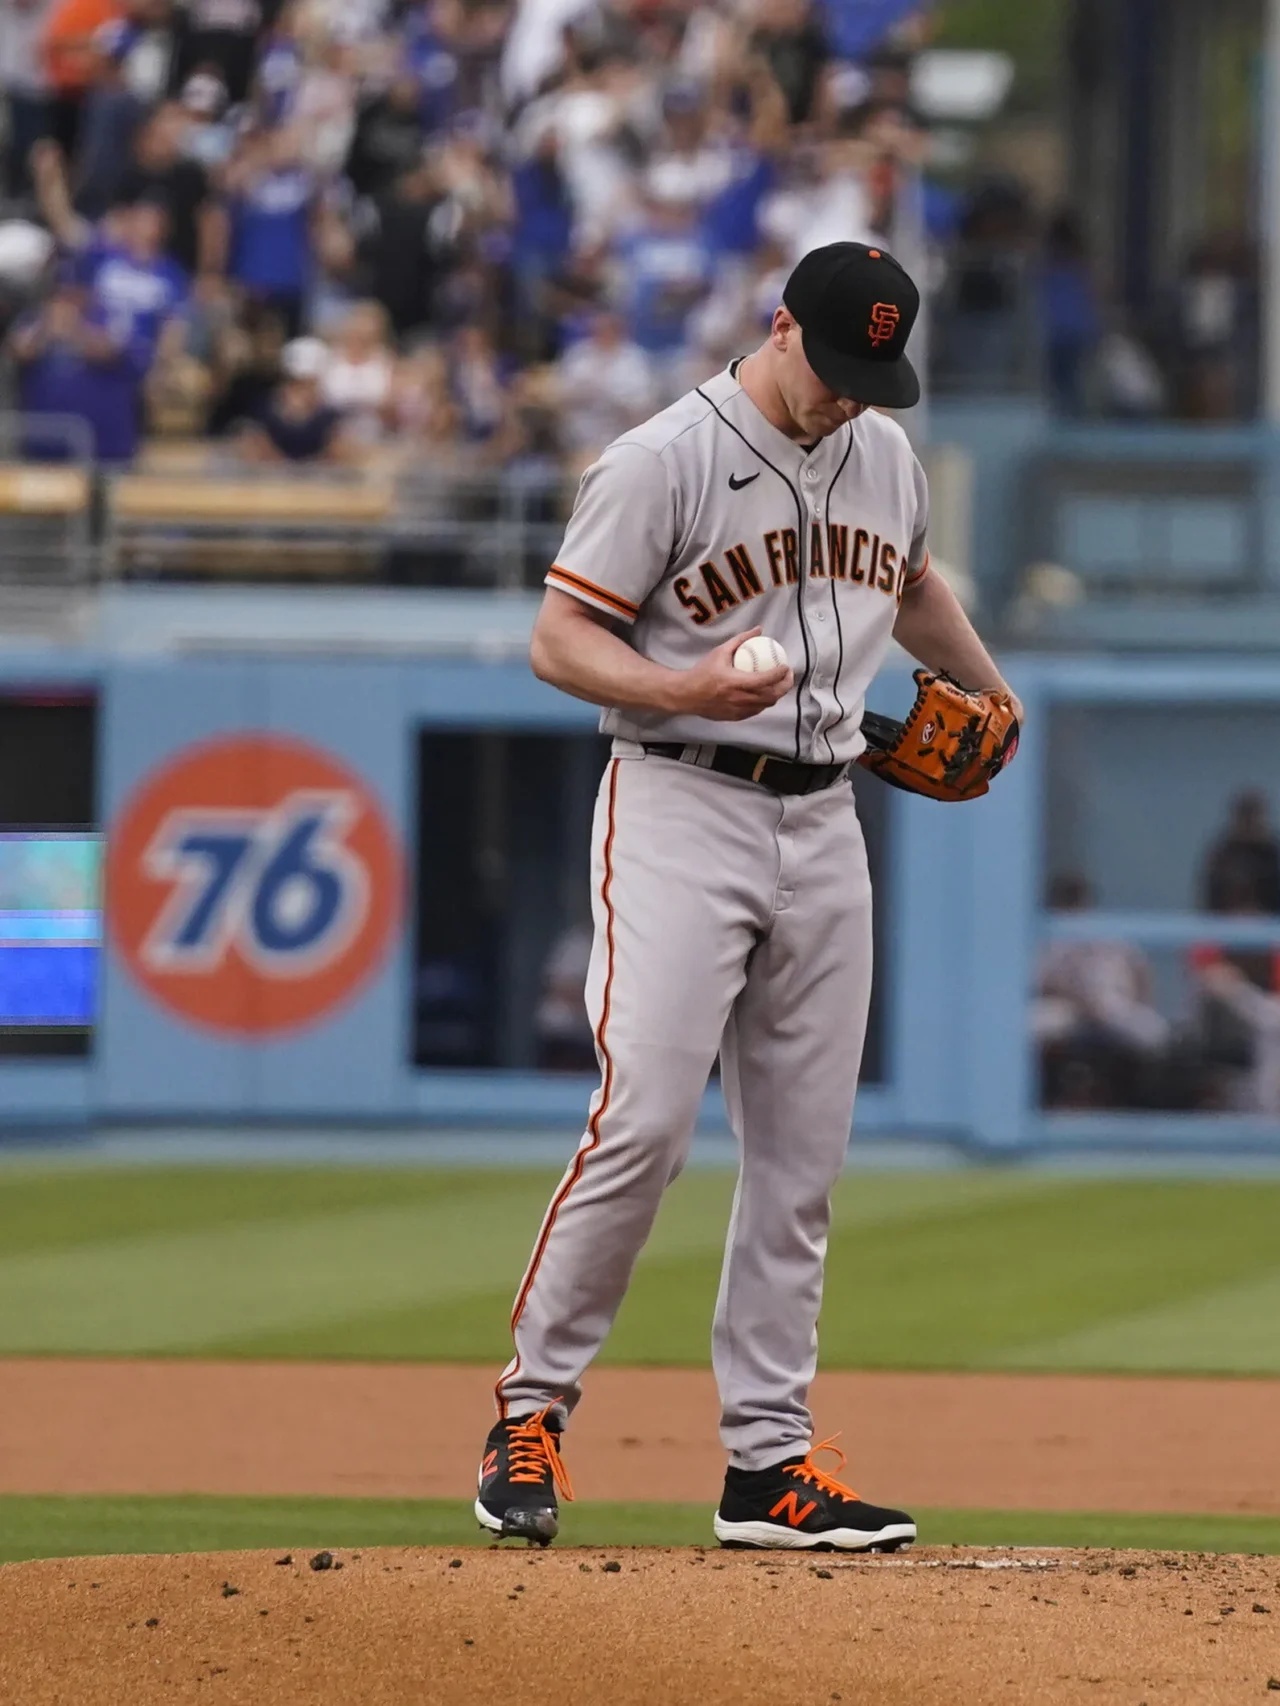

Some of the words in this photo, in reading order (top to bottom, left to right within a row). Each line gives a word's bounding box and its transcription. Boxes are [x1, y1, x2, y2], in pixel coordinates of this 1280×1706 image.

[868, 302, 900, 348] SF
[673, 543, 764, 625] SAN
[152, 796, 361, 974] 76
[768, 1490, 817, 1527] N
